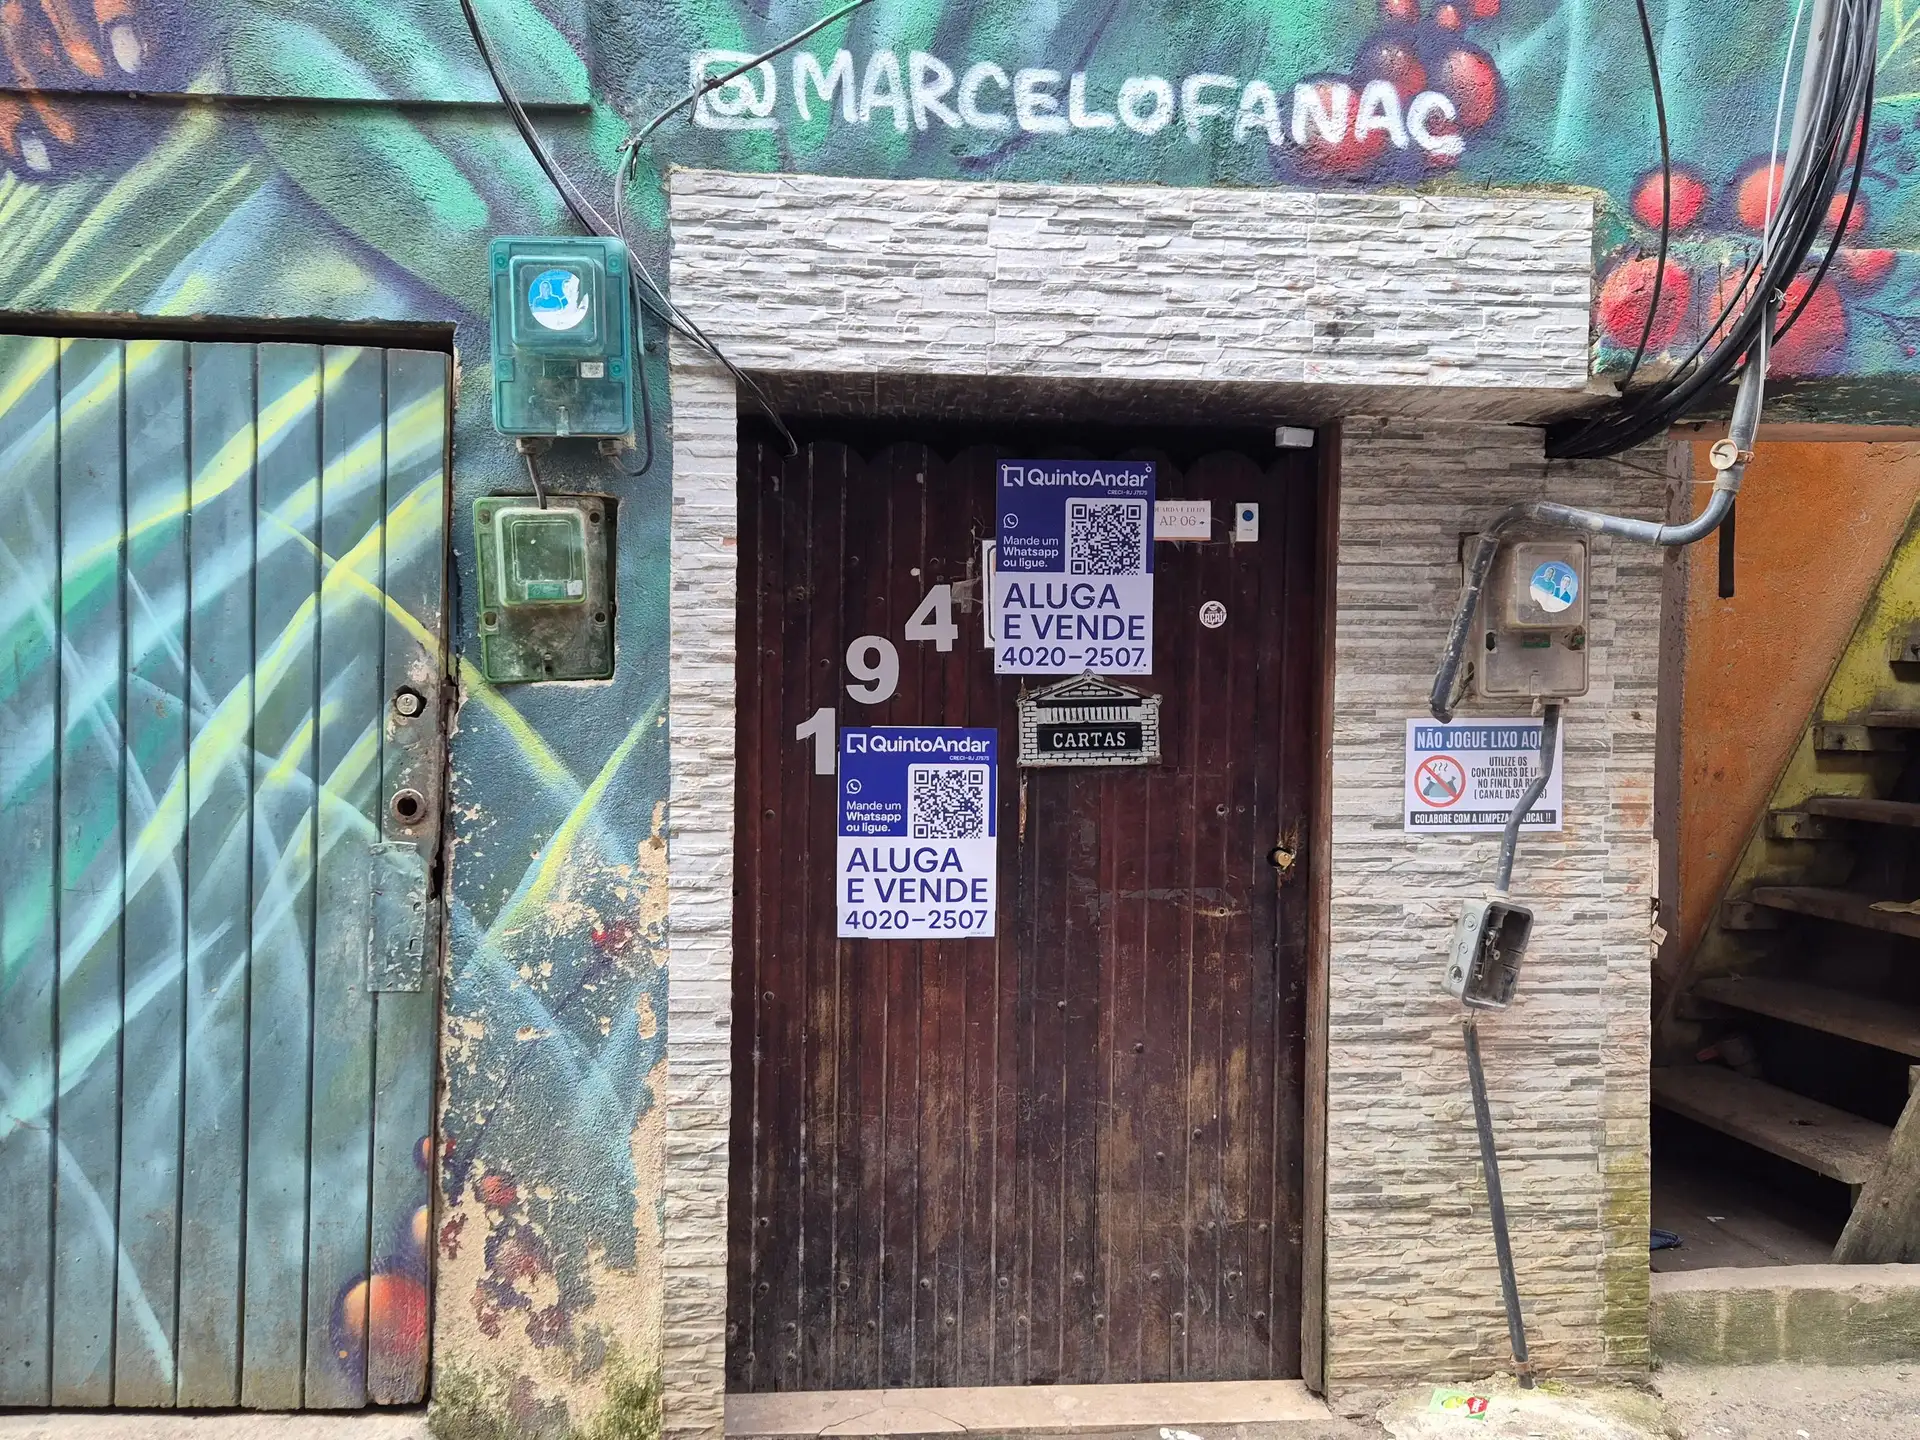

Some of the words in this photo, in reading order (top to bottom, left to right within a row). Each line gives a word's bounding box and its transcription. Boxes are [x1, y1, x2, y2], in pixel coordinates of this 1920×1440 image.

[1027, 468, 1148, 488] QuintoAndar
[1160, 515, 1177, 526] AP
[1180, 515, 1197, 526] 06
[1003, 535, 1040, 546] Mande
[1042, 538, 1059, 546] um
[1003, 546, 1059, 559] Whatsapp
[1003, 559, 1017, 567] ou
[1019, 557, 1048, 570] ligue.
[1002, 583, 1120, 609] ALUGA
[1003, 614, 1021, 641] E
[1031, 614, 1145, 641] VENDE
[1001, 647, 1145, 667] 4020-2507
[870, 735, 990, 753] QuintoAndar
[1052, 731, 1127, 748] CARTAS
[1417, 728, 1443, 749] NÃO
[1446, 731, 1487, 748] JOGUE
[1491, 731, 1517, 748] LIXO
[1489, 756, 1516, 767] UTILIZE
[1518, 756, 1528, 766] OS
[1471, 767, 1518, 778] CONTAINERS
[1520, 767, 1528, 777] DE
[1478, 778, 1488, 788] NO
[1490, 778, 1512, 788] FINAL
[1513, 778, 1523, 788] DA
[1479, 789, 1504, 799] CANAL
[1506, 789, 1520, 799] DAS
[846, 801, 882, 811] Mande
[884, 803, 901, 811] um
[846, 812, 902, 824] Whatsapp
[1415, 813, 1452, 824] COLABORE
[1454, 813, 1471, 824] COM
[1472, 813, 1477, 823] A
[1478, 812, 1509, 823] LIMPEZA
[846, 824, 860, 832] ou
[862, 822, 891, 834] ligue.
[846, 847, 963, 873] ALUGA
[847, 878, 864, 903] E
[874, 878, 988, 903] VENDE
[845, 909, 988, 930] 4020-2507
